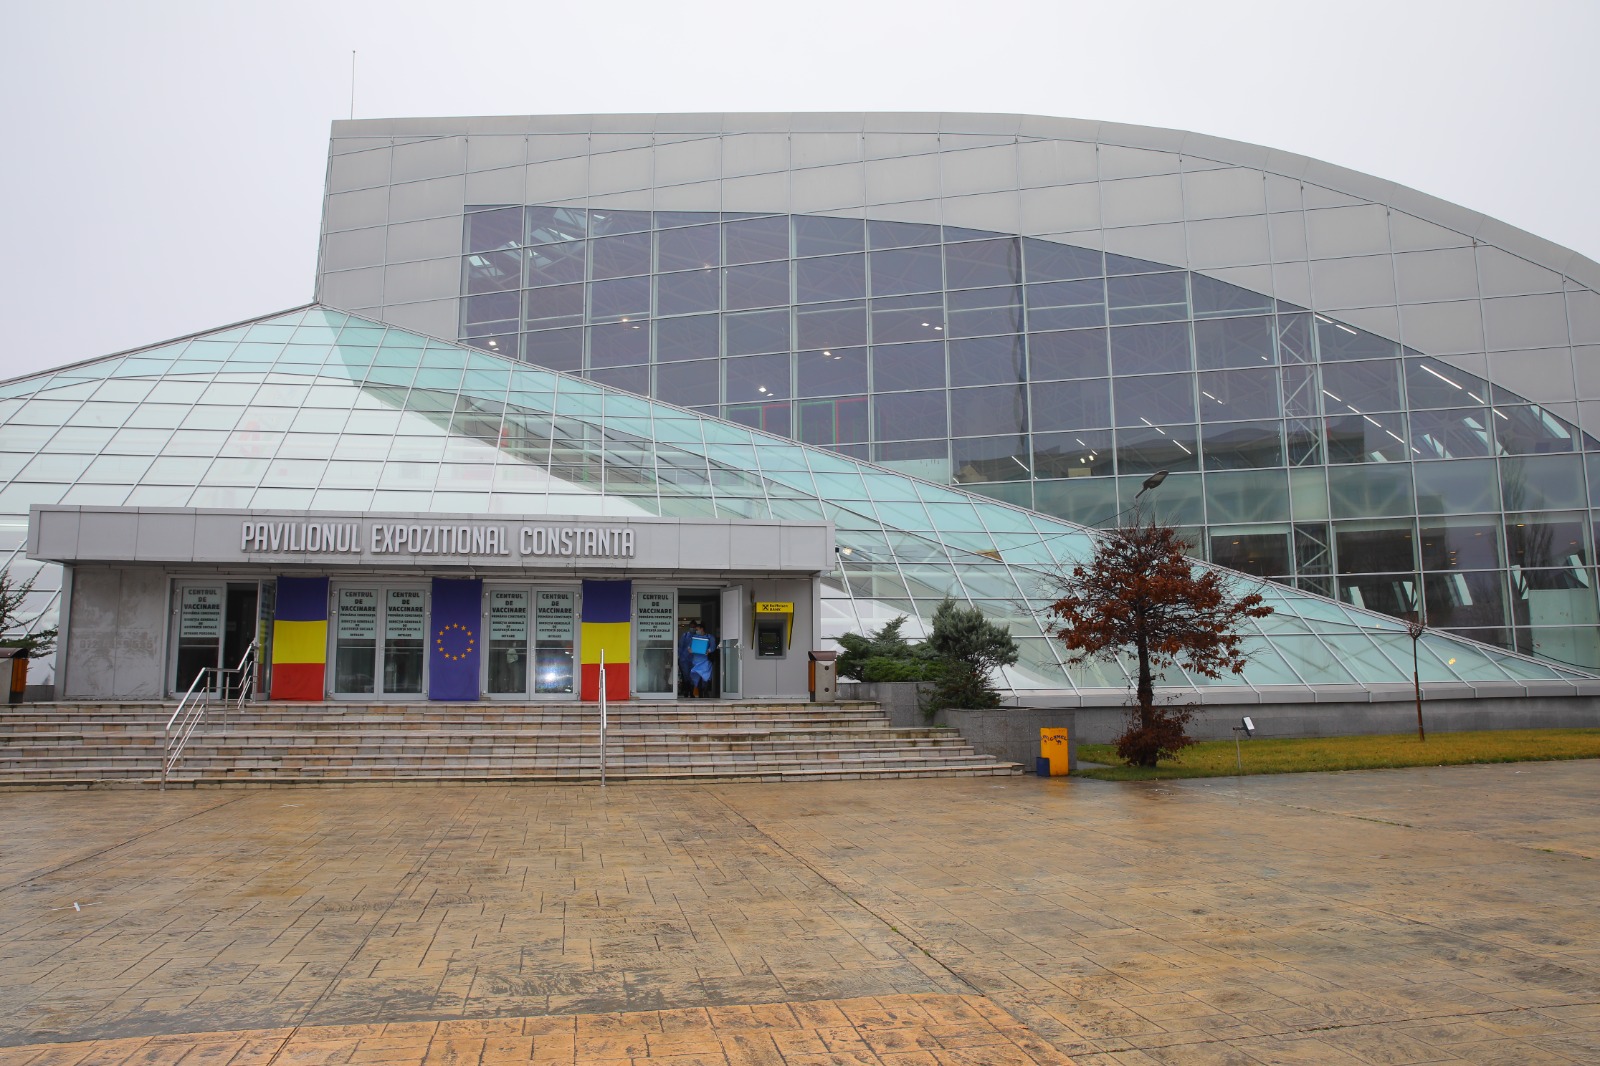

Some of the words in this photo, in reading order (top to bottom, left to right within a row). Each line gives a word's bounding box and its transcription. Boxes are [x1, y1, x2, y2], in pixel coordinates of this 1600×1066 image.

[241, 522, 361, 553] PAVILIONUL
[371, 524, 510, 556] EXPOZITIONAL
[520, 527, 634, 558] CONSTANTA
